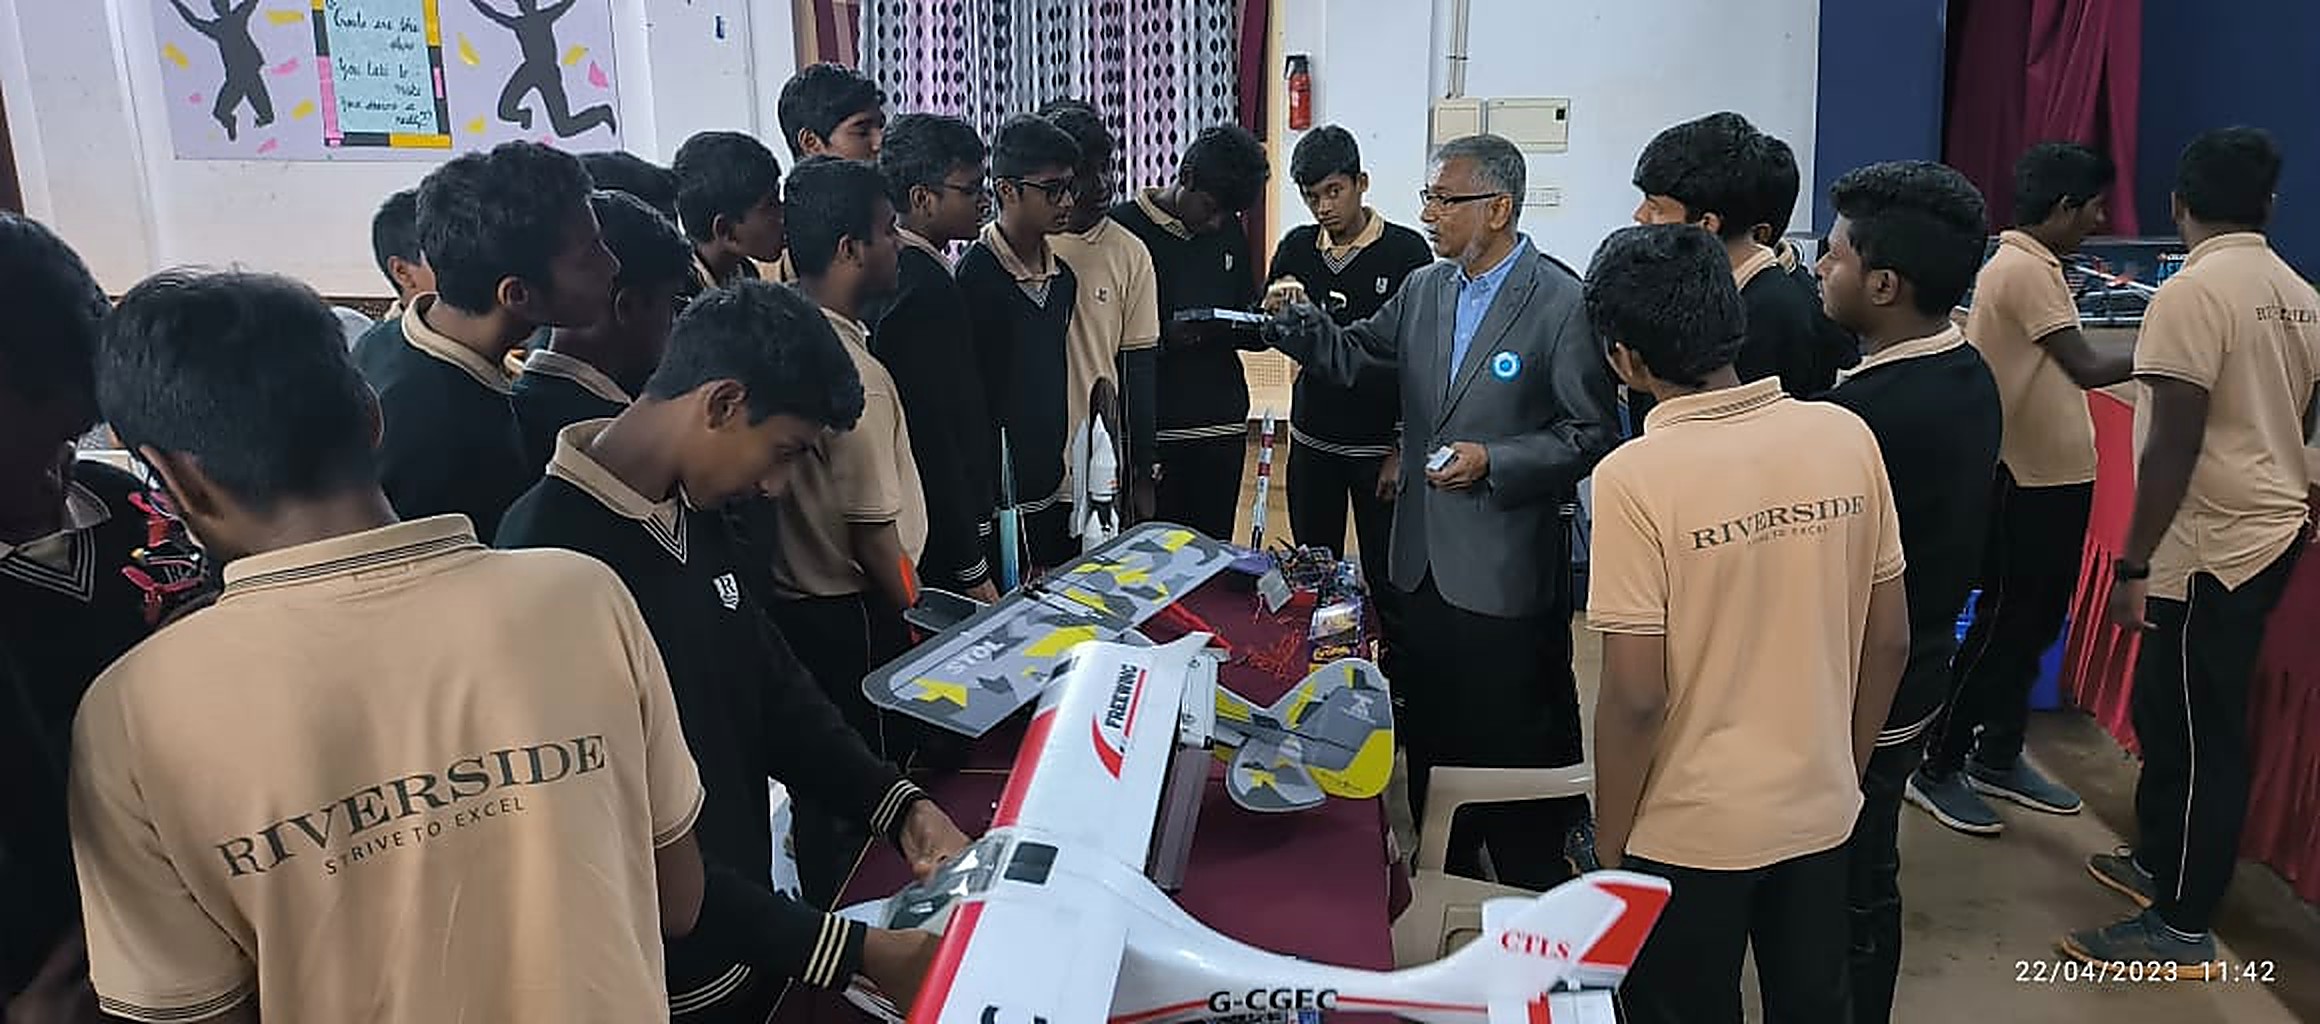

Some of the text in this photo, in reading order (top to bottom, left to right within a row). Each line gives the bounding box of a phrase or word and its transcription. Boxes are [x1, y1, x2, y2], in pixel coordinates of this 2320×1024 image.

[1689, 496, 1864, 550] RIVERSIDE
[1104, 663, 1138, 729] FREEWING
[216, 735, 606, 877] RIVERSIDE
[324, 796, 525, 875] STRIVE TO EXCEL
[1500, 930, 1571, 959] CTLS
